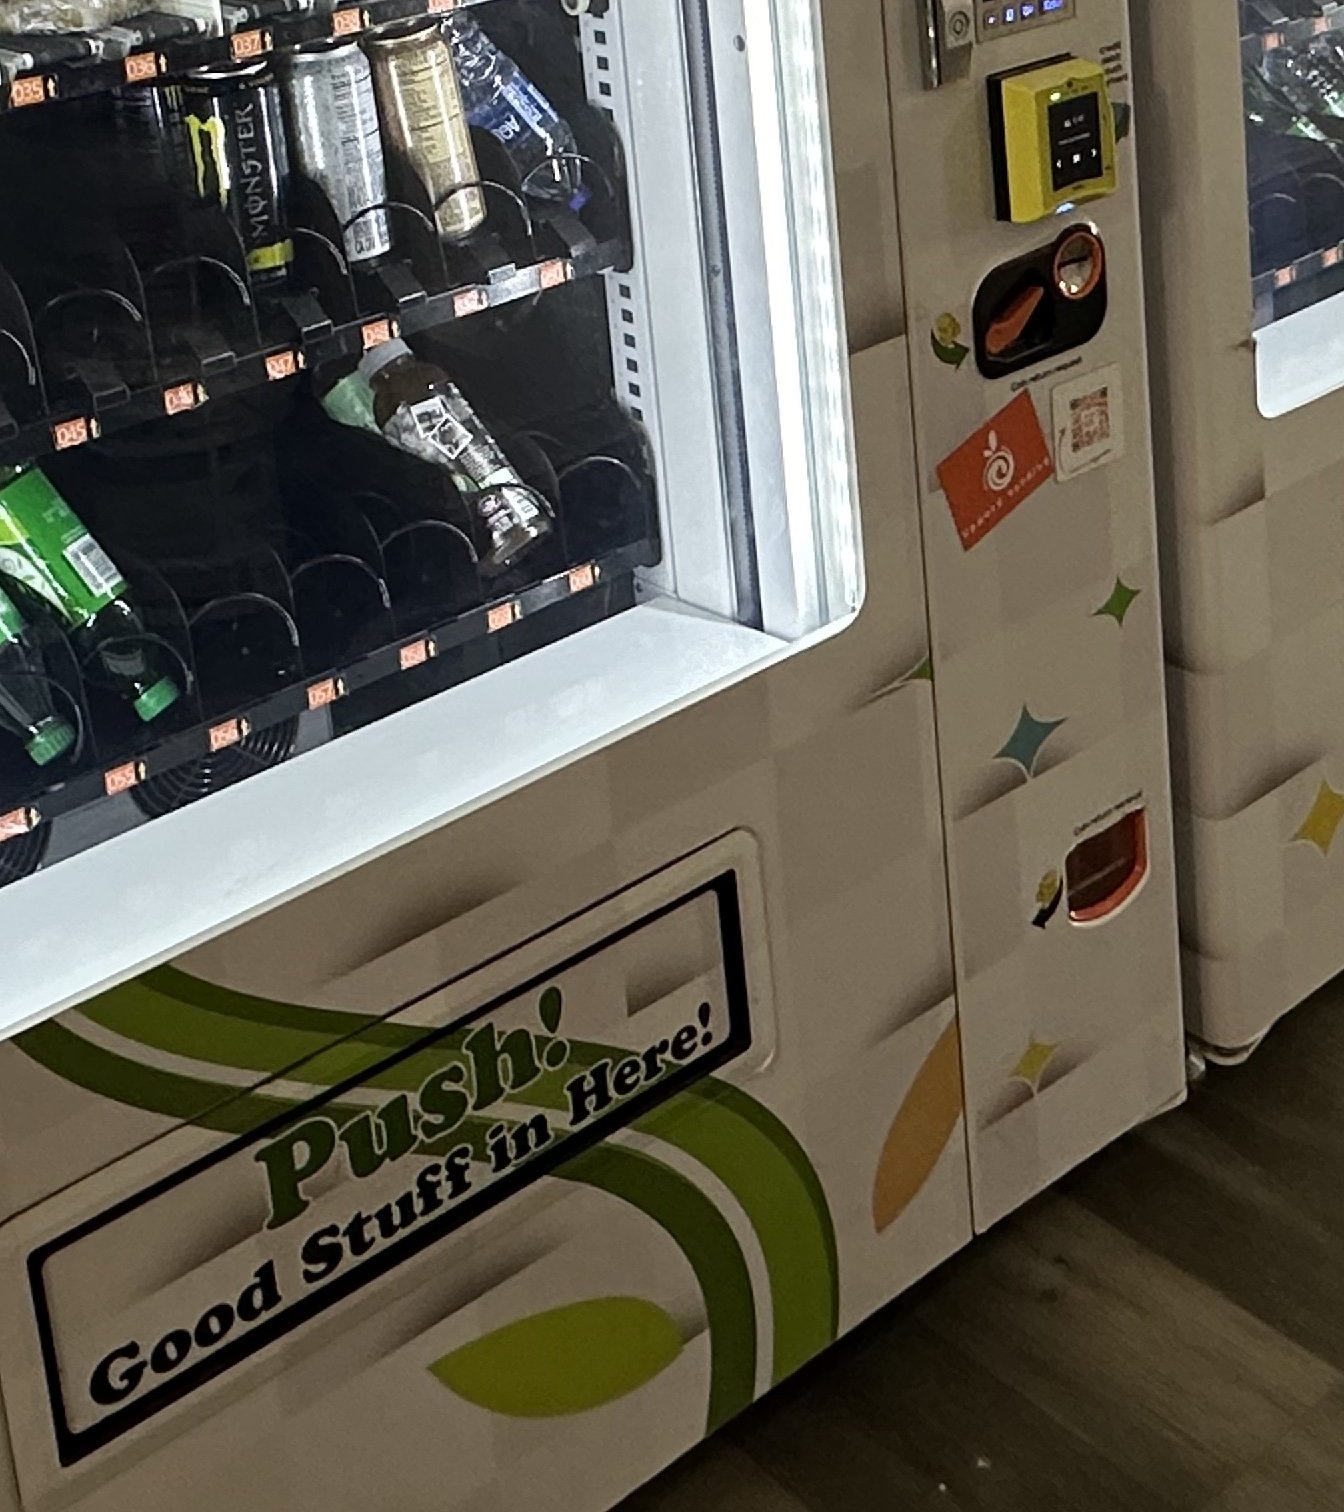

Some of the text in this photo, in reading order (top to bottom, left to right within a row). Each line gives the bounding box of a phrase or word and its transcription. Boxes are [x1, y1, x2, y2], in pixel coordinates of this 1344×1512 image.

[233, 33, 260, 56] 037
[126, 57, 155, 77] 036
[14, 79, 43, 101] 035
[233, 100, 269, 241] MONSTER
[56, 422, 87, 446] 045
[256, 985, 565, 1233] Push!
[89, 1000, 714, 1407] Good Stuff in Here!
